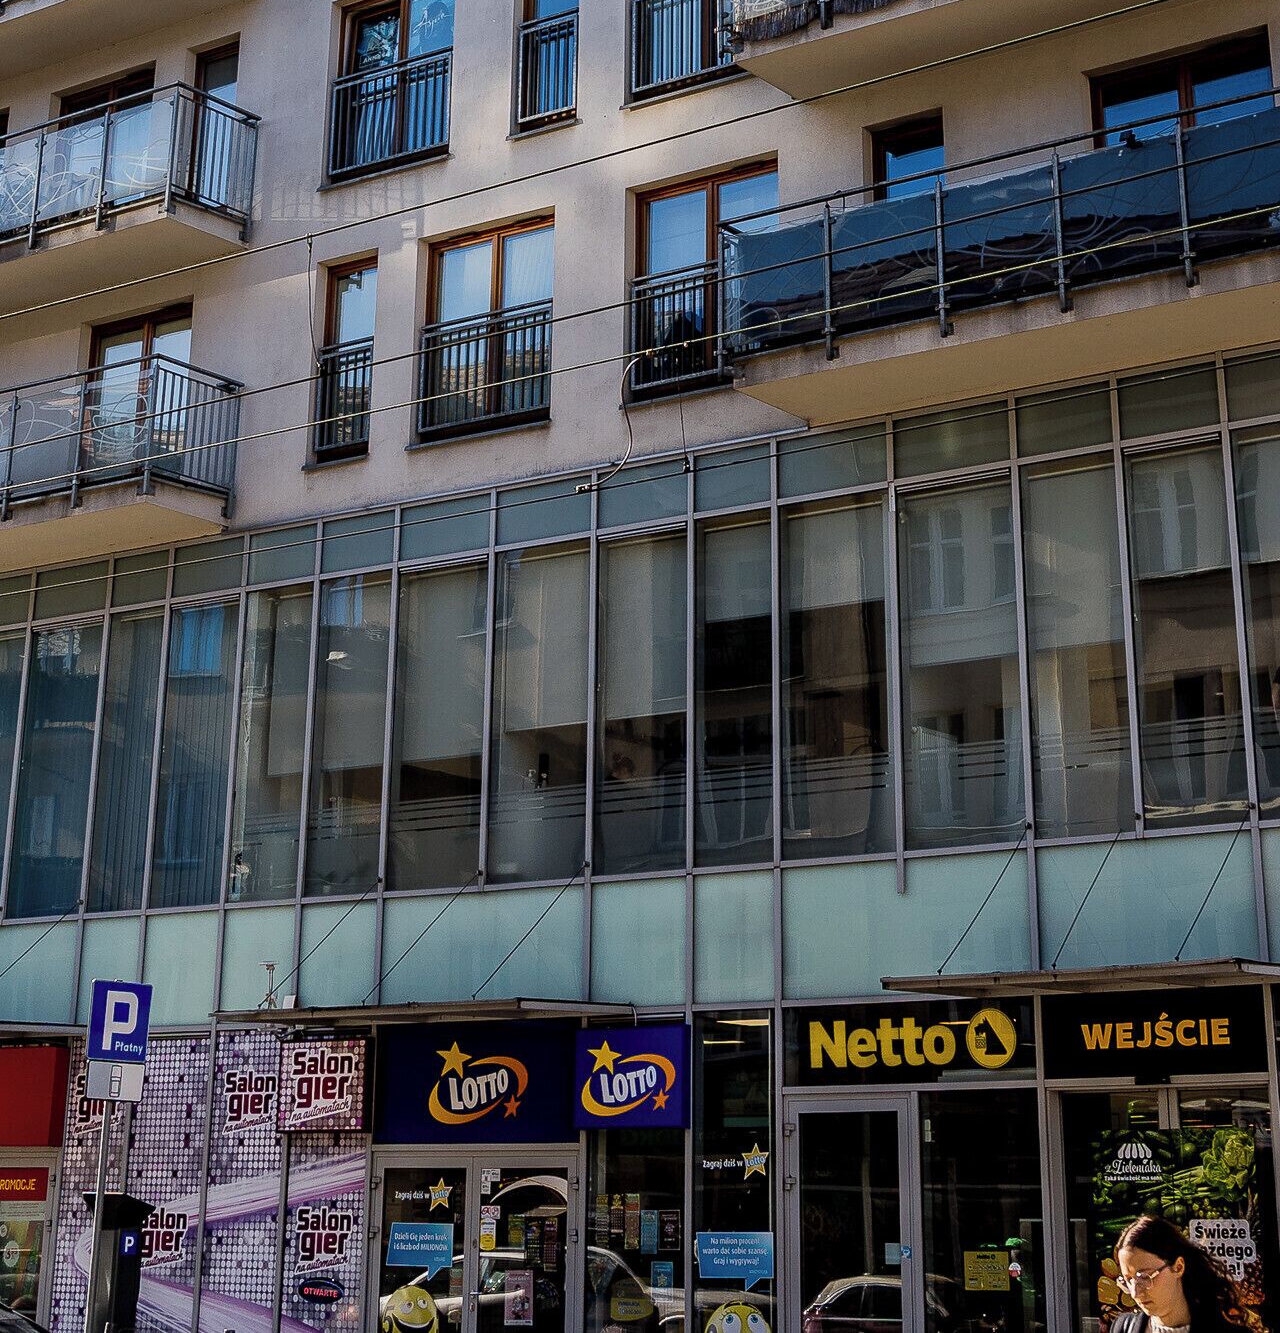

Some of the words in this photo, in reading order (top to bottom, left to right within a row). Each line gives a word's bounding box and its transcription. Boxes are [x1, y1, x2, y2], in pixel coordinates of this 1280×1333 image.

[101, 990, 138, 1051] P
[1081, 1012, 1231, 1050] WEJŚCIE
[115, 1041, 143, 1055] Płatny
[808, 1017, 956, 1069] Netto
[292, 1049, 353, 1075] Salon
[224, 1070, 277, 1093] Salon
[296, 1075, 351, 1108] gier
[448, 1068, 509, 1110] LOTTO
[600, 1065, 657, 1103] LOTTO
[228, 1094, 274, 1122] gier
[303, 1097, 349, 1118] automatach
[703, 1159, 722, 1170] Zagraj
[723, 1158, 735, 1168] dziś
[1112, 1159, 1162, 1174] Zieleniaka
[395, 1191, 412, 1201] Zagraj
[412, 1191, 424, 1199] dziś
[297, 1208, 352, 1231] Salon
[1194, 1222, 1247, 1239] Świeże
[299, 1232, 349, 1261] gier
[394, 1232, 409, 1240] Dzieli
[410, 1233, 418, 1242] Cię
[418, 1233, 434, 1242] jeden
[435, 1232, 448, 1240] krok
[713, 1257, 725, 1265] Graj
[729, 1257, 760, 1266] wygrywaj!
[303, 1287, 338, 1298] OTWARTE
